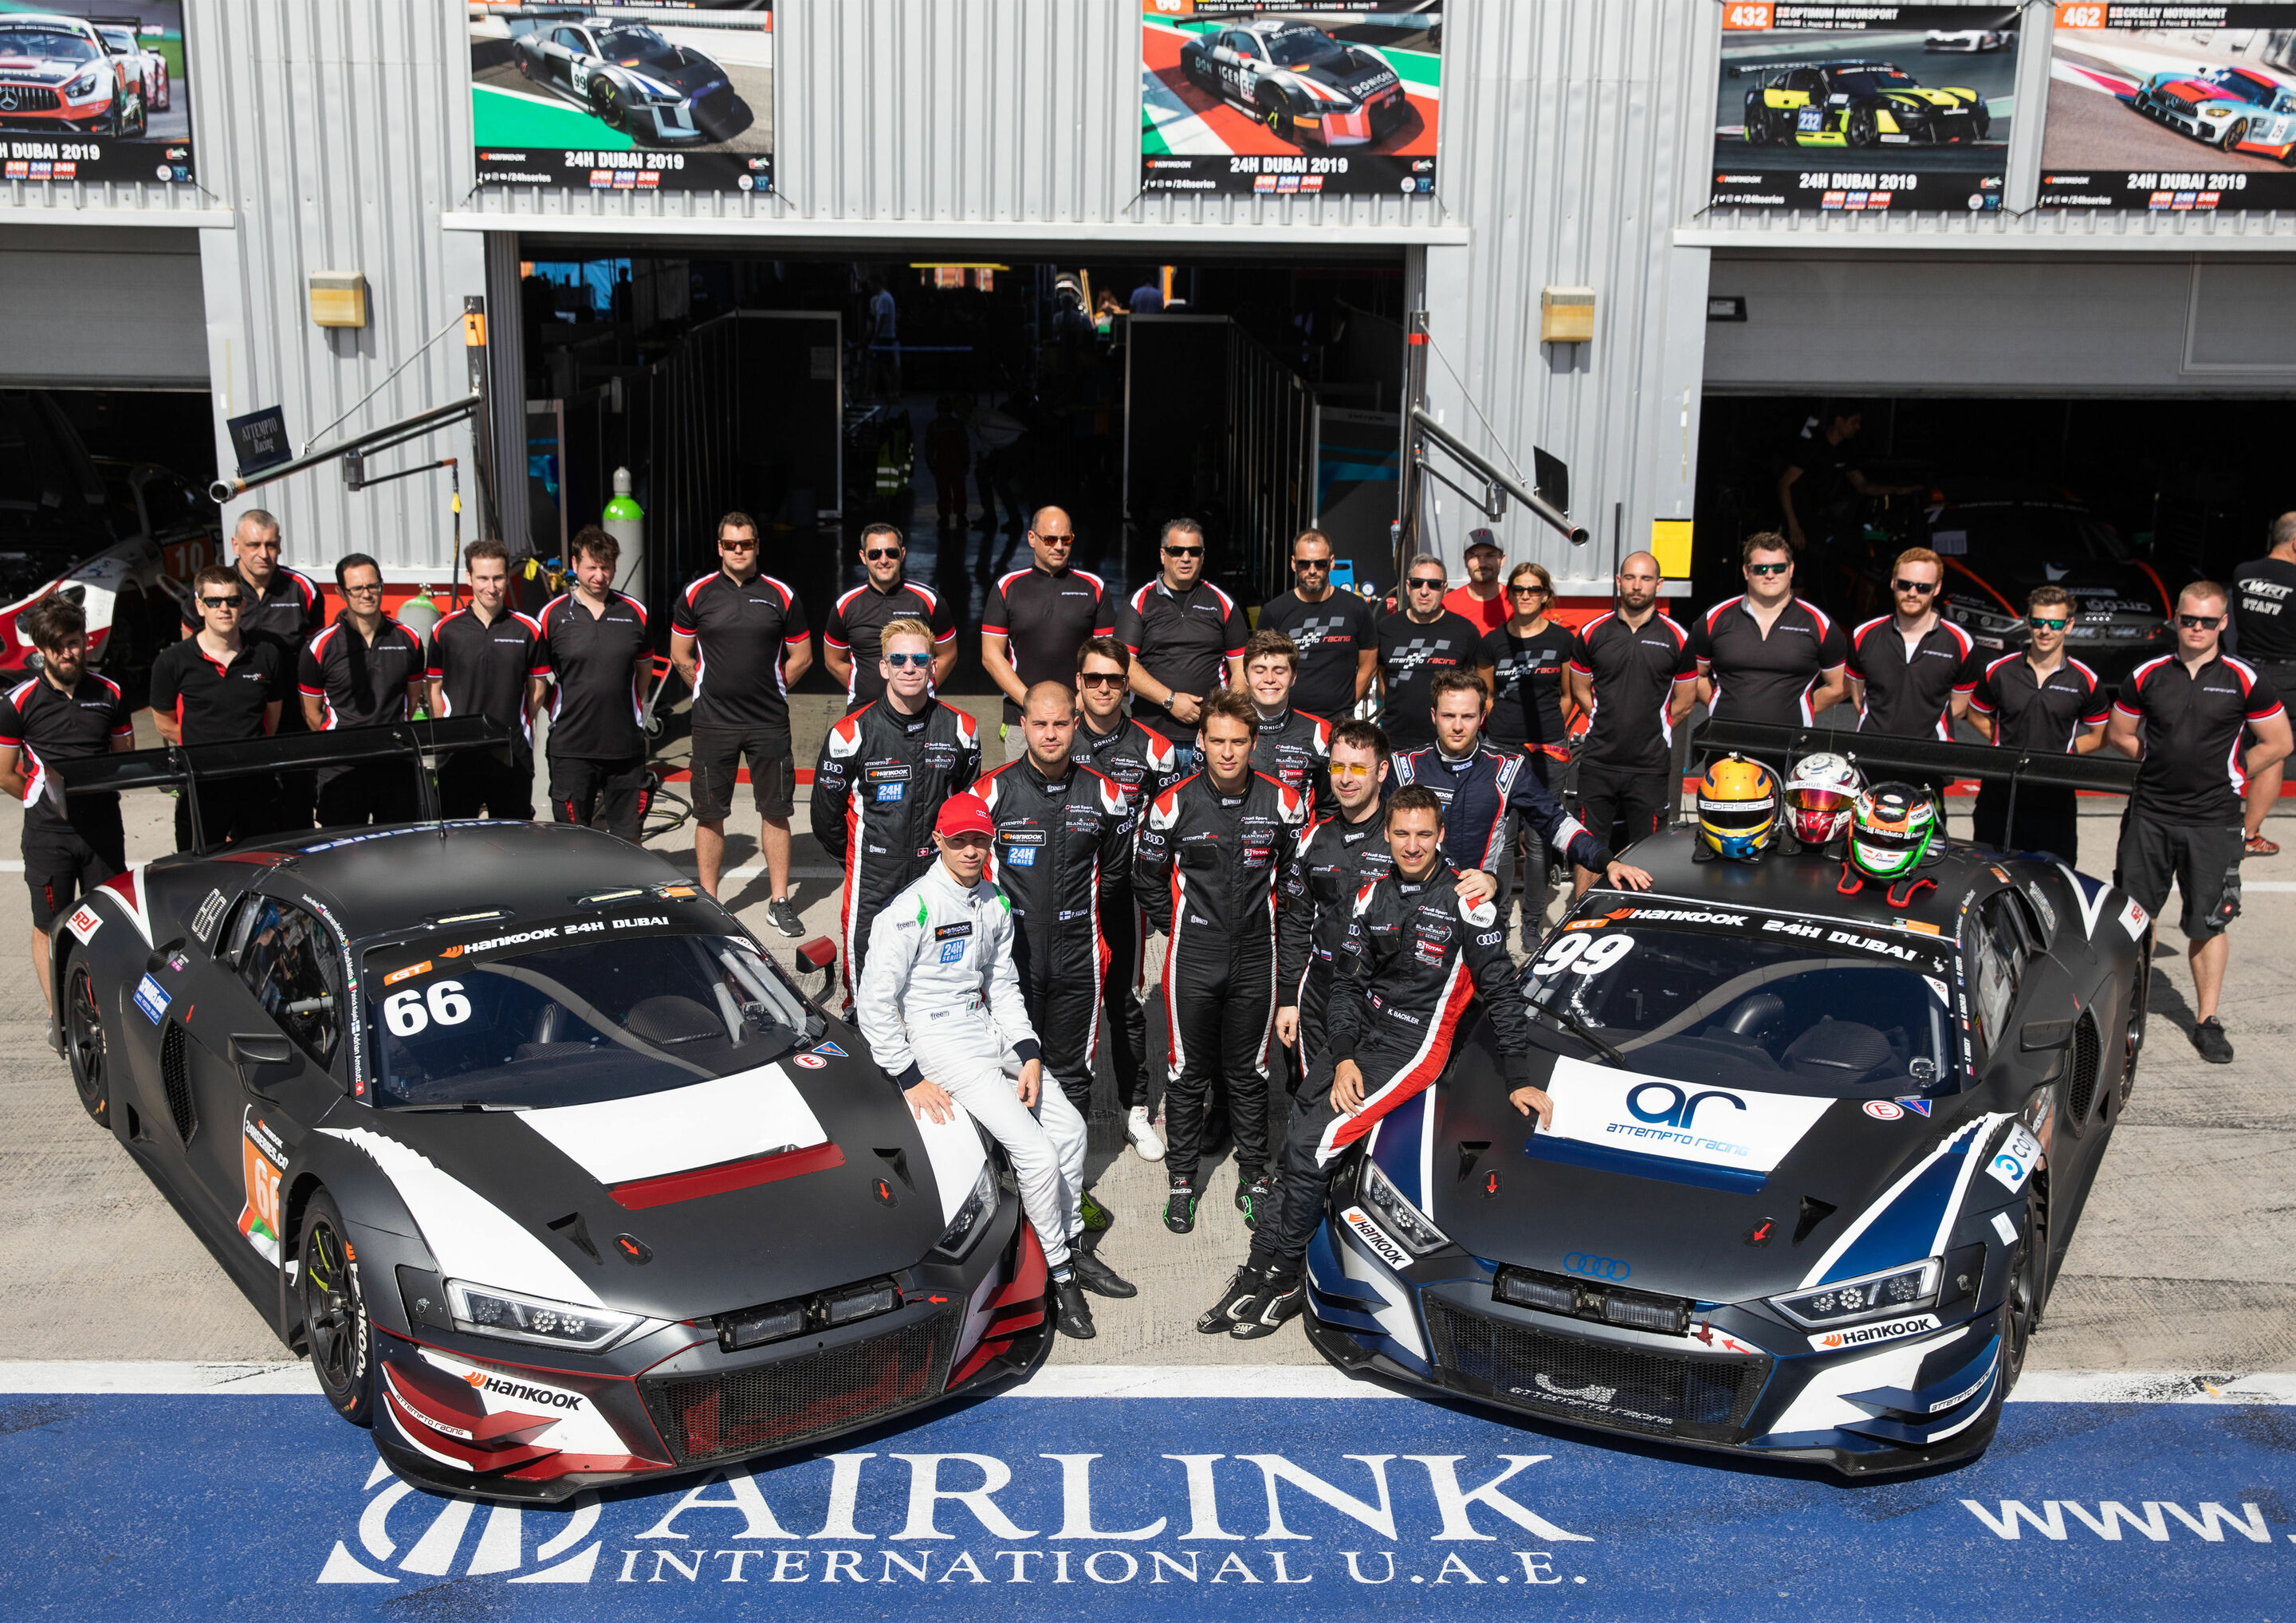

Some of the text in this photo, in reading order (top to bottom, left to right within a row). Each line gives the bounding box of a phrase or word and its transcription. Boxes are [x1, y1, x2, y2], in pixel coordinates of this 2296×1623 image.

[1730, 6, 1767, 26] 432
[1791, 7, 1899, 20] OPTIMUM MOTORSPORT
[2063, 6, 2101, 27] 462
[2124, 7, 2227, 20] CICELEY MOTORSPORT
[574, 73, 587, 90] 99
[1799, 112, 1820, 131] 232
[12, 143, 100, 160] DUBAI 2019
[564, 151, 685, 169] 24H DUBAI 2019
[1230, 157, 1348, 173] 24H DUBAI 2019
[1256, 176, 1277, 185] 24H
[1279, 176, 1299, 185] 24H
[1302, 176, 1323, 185] 24H
[1799, 173, 1917, 190] 24H DUBAI 2019
[2127, 173, 2247, 190] 24H DUBAI 2019
[241, 417, 278, 443] ATTEMPTO
[175, 541, 205, 577] 10
[2247, 580, 2294, 600] WRT
[2242, 598, 2283, 616] STAFF
[1389, 655, 1457, 666] attempto racing
[1093, 734, 1119, 748] DONIGER
[1399, 756, 1411, 779] sparco
[1452, 760, 1472, 772] sparco
[1500, 760, 1513, 783] sparco
[879, 784, 902, 796] 24H
[1703, 799, 1774, 810] PORSCHE
[1009, 847, 1035, 859] 24H
[1422, 910, 1444, 920] customer
[564, 921, 605, 936] 24H
[612, 916, 670, 930] DUBAI
[897, 919, 917, 931] freem
[1415, 923, 1446, 937] BLANCPAIN
[1571, 919, 1605, 929] GT
[945, 941, 964, 956] 24H
[1425, 943, 1443, 953] TOTAL
[1762, 919, 1822, 940] 24H
[1827, 932, 1918, 961] DUBAI
[942, 953, 962, 962] SERIES
[1532, 933, 1635, 976] 99
[391, 963, 425, 983] GT
[383, 980, 472, 1037] 66
[930, 1010, 950, 1020] freem
[1394, 1010, 1420, 1025] BACHLER
[1626, 1082, 1747, 1130] ar
[1877, 1104, 1890, 1115] E
[246, 1119, 289, 1170] 24HSERIES.CO
[1606, 1122, 1750, 1156] attempto racing
[1931, 1386, 1972, 1412] attempto
[396, 1393, 464, 1436] attempto racing
[644, 1452, 1596, 1542] AIRLINK
[615, 1548, 1589, 1586] INTERNATIONAL U.A.E.
